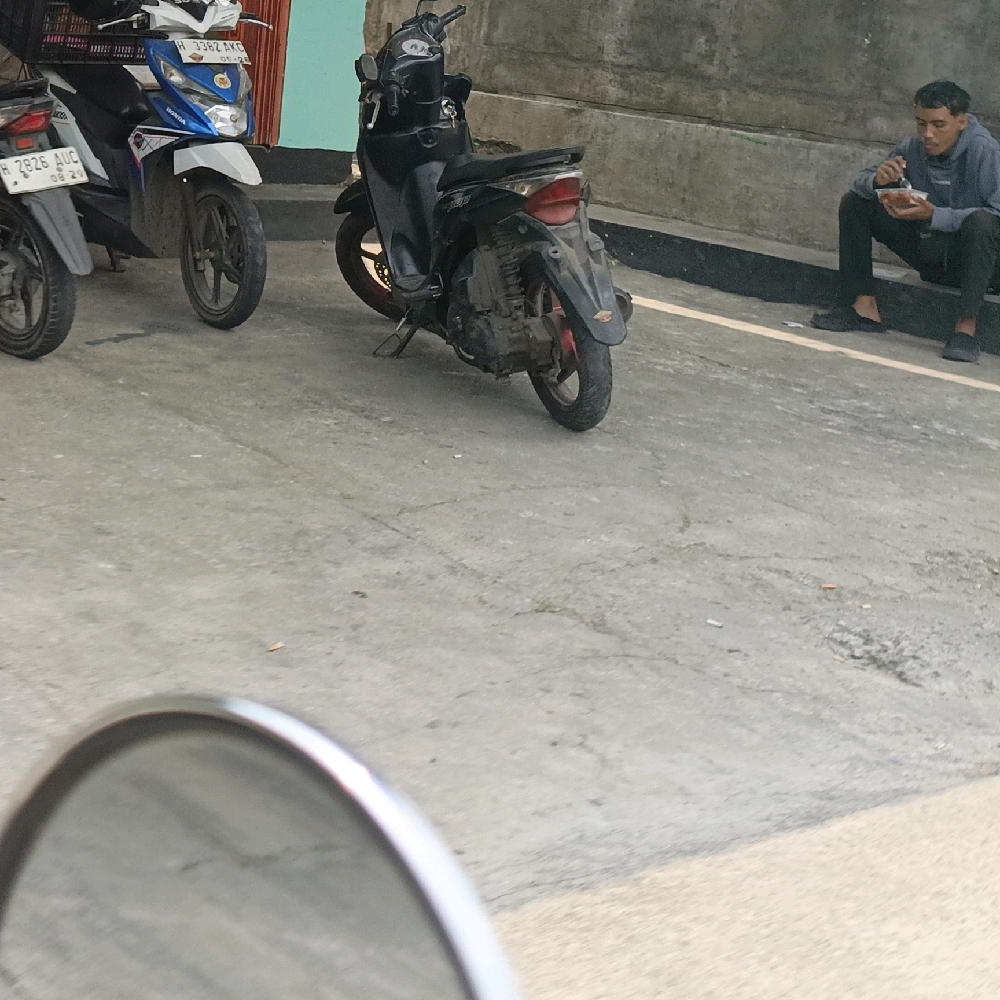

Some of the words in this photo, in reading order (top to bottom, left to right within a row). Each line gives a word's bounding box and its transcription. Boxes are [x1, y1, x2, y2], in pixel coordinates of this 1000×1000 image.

[176, 40, 186, 51] H
[192, 41, 222, 53] 3382
[0, 162, 11, 176] H
[14, 155, 50, 174] 2826
[53, 150, 79, 168] AUC
